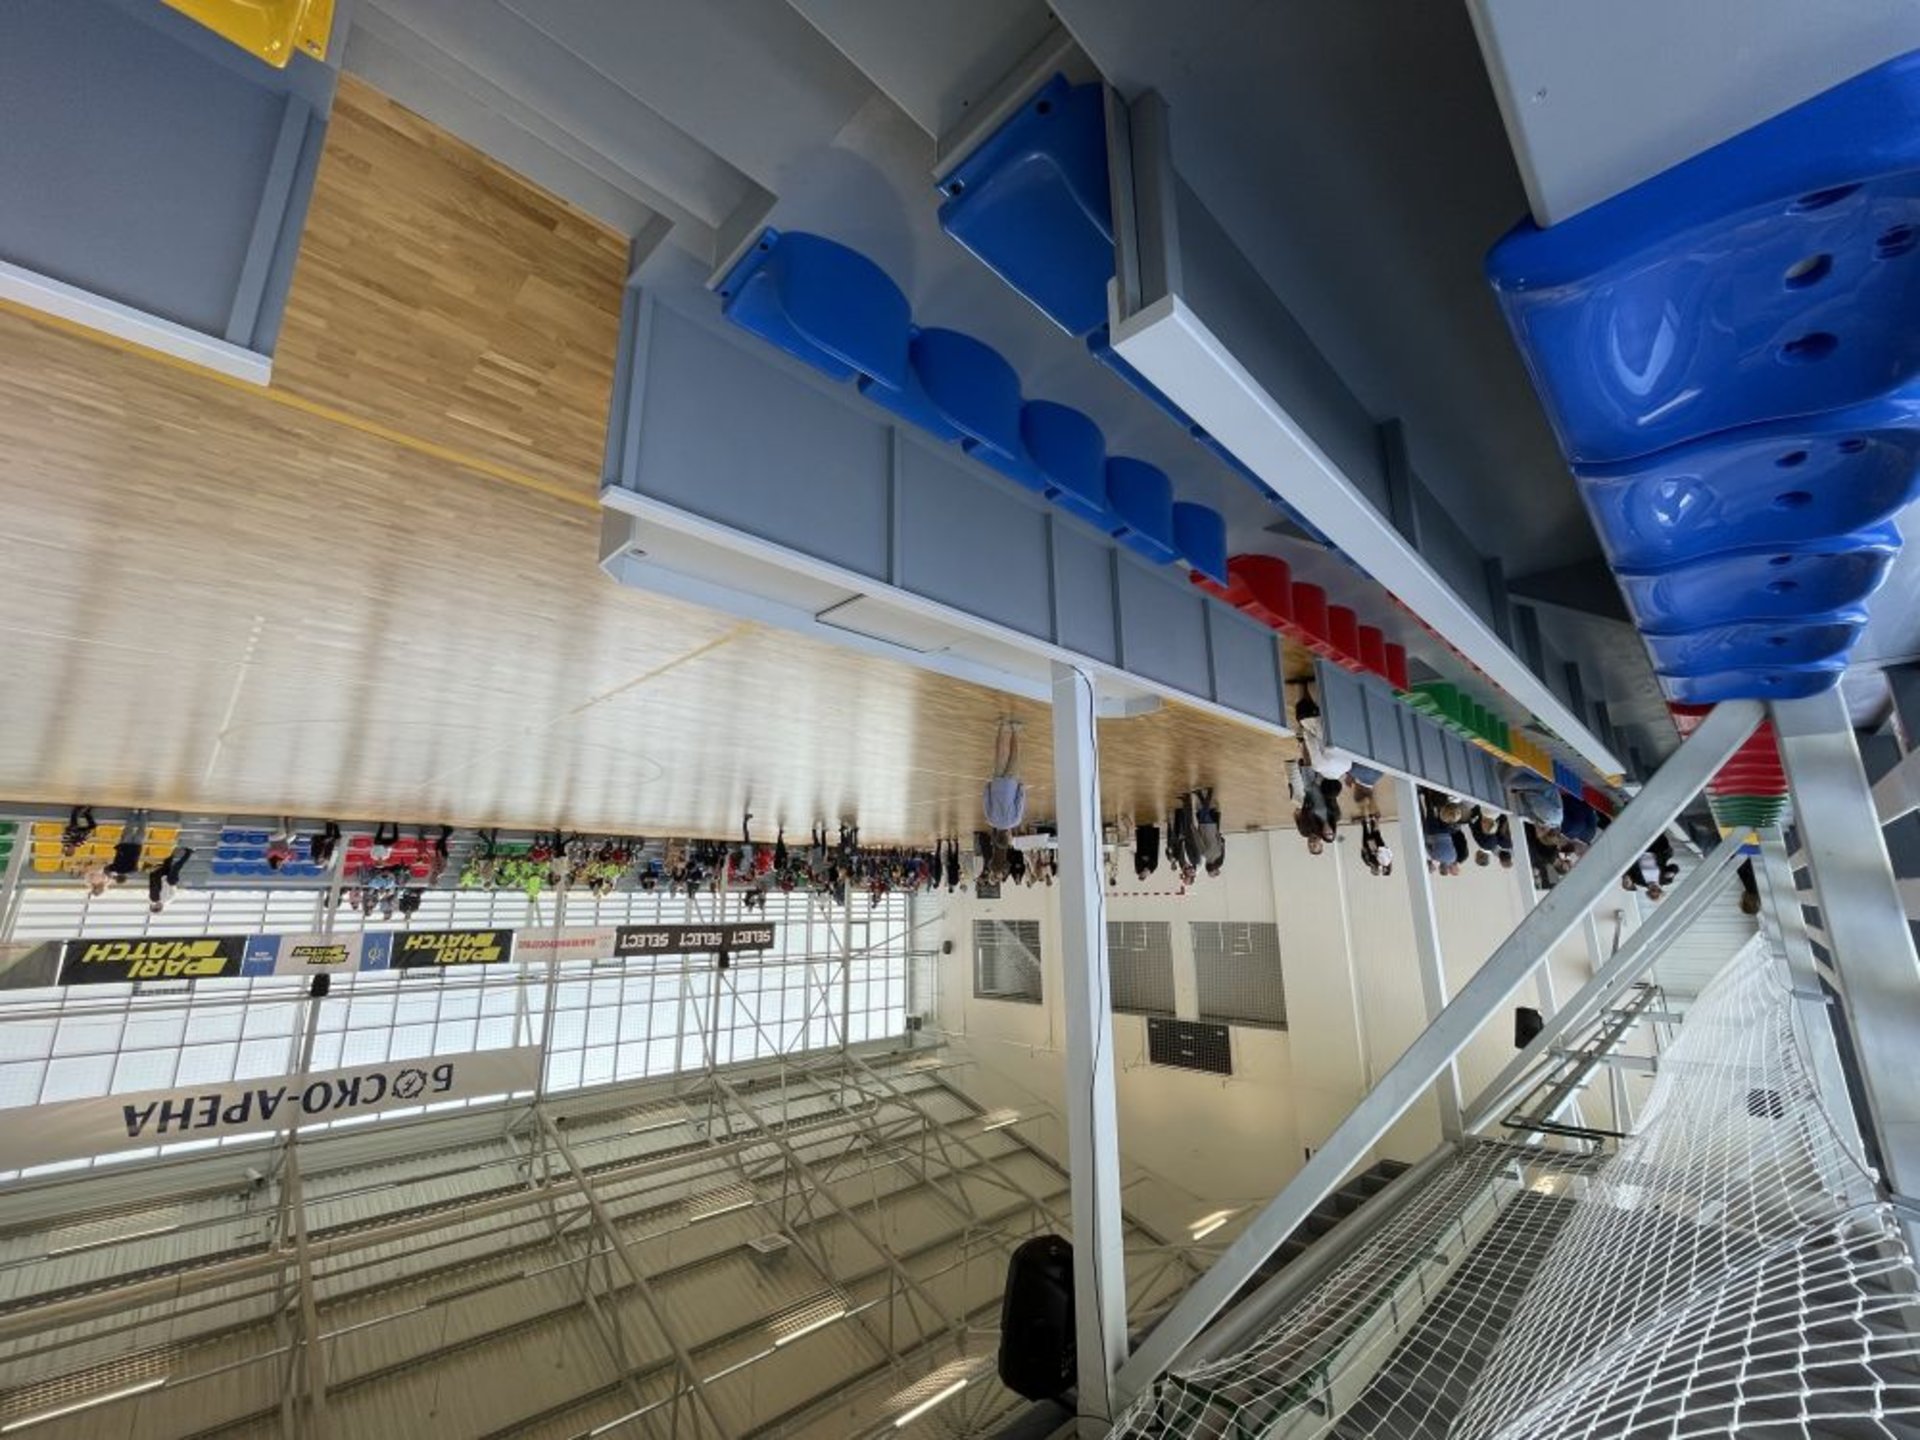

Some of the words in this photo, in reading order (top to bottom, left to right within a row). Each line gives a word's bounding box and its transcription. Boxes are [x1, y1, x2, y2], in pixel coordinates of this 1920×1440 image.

[405, 933, 494, 950] MATCH
[619, 932, 670, 949] SELECT
[679, 930, 723, 946] SELECT
[731, 930, 772, 944] SELECT
[82, 940, 221, 962] MATCH
[434, 946, 500, 963] PARI
[127, 957, 228, 978] PARI
